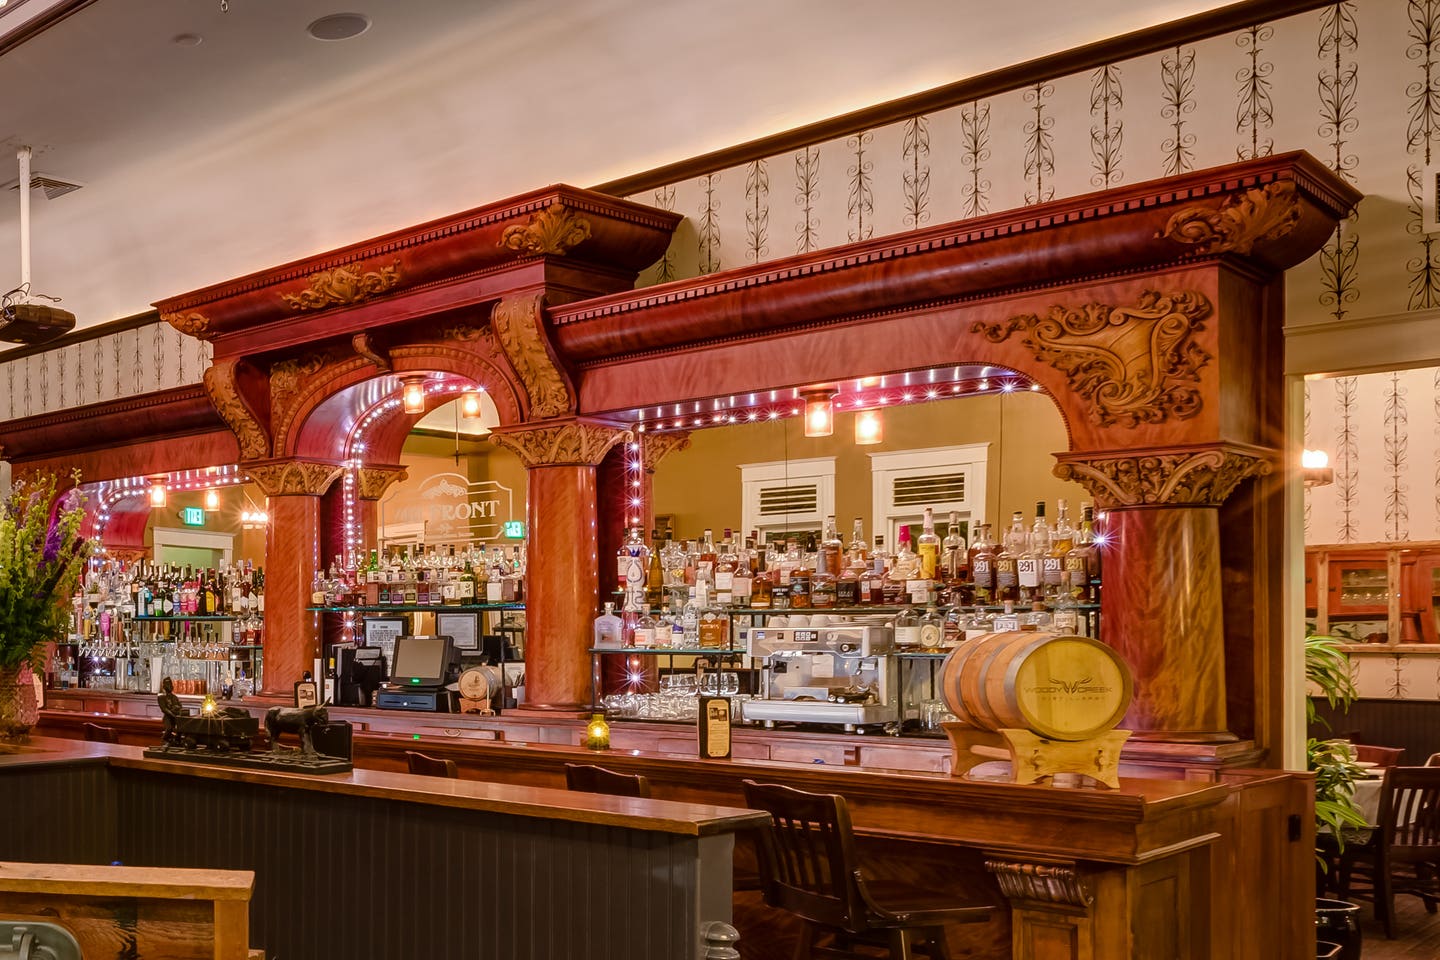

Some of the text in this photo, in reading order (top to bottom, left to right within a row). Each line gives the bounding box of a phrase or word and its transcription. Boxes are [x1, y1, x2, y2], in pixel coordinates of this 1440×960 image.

[975, 560, 989, 572] 291
[997, 560, 1014, 572] 291
[1019, 560, 1035, 572] 291
[1043, 558, 1061, 571] 291
[1067, 558, 1084, 570] 291
